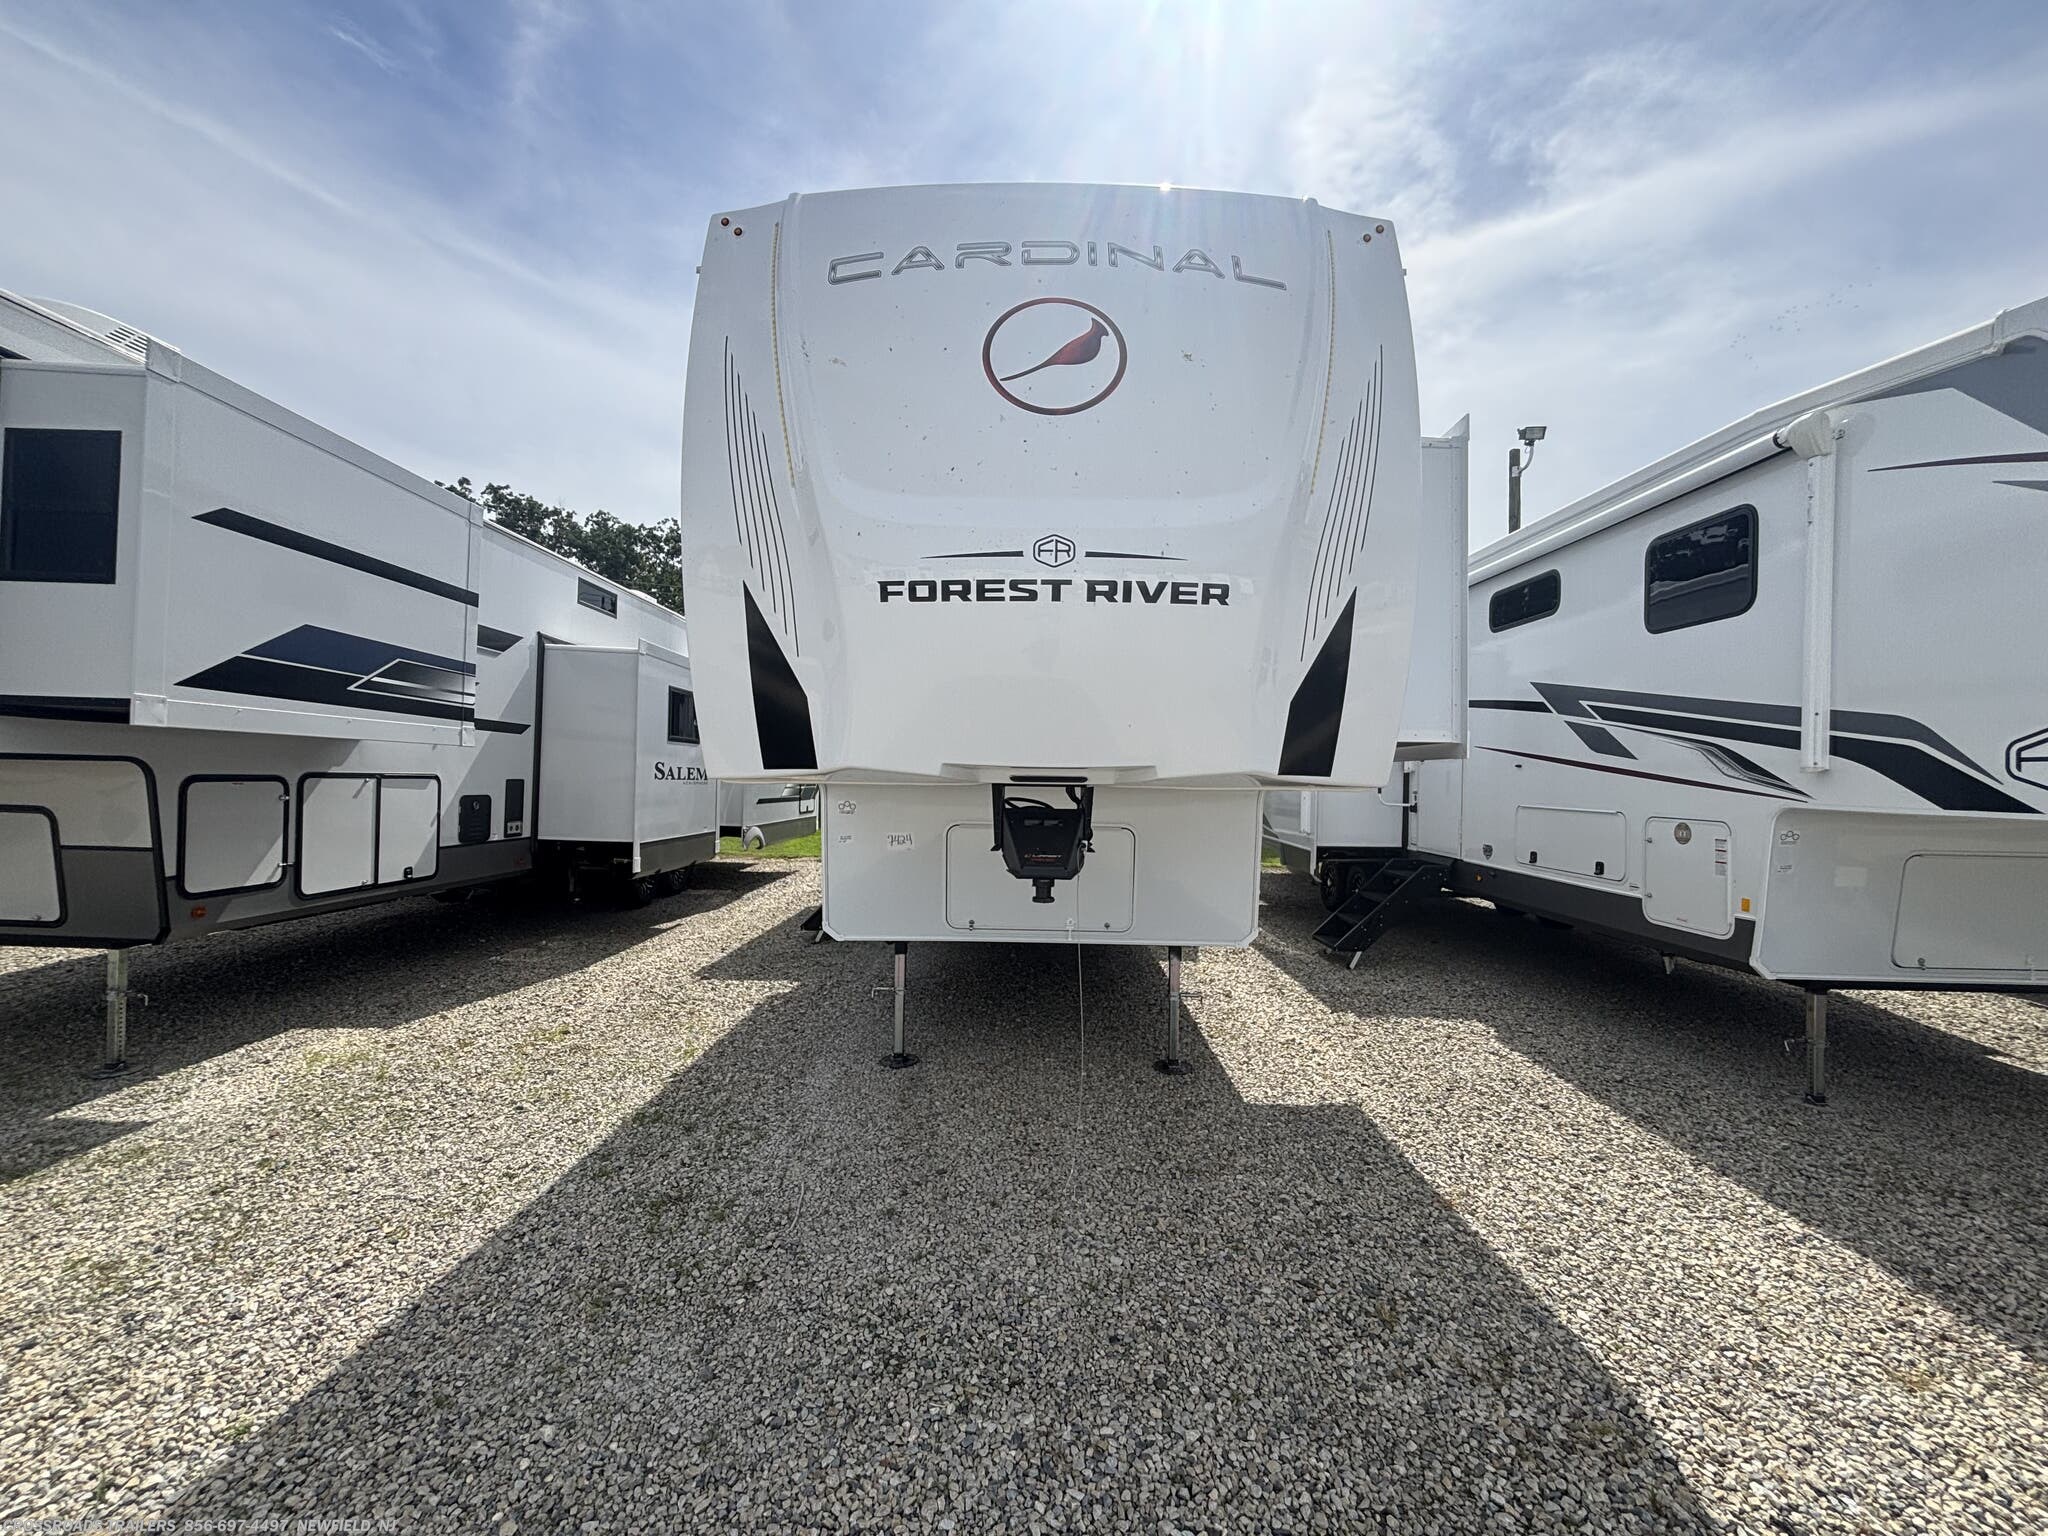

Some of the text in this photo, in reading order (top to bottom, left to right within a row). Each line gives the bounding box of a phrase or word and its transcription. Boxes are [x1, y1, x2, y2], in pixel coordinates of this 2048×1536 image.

[826, 241, 1287, 290] CARDINAL
[877, 578, 1231, 606] FOREST RIVER
